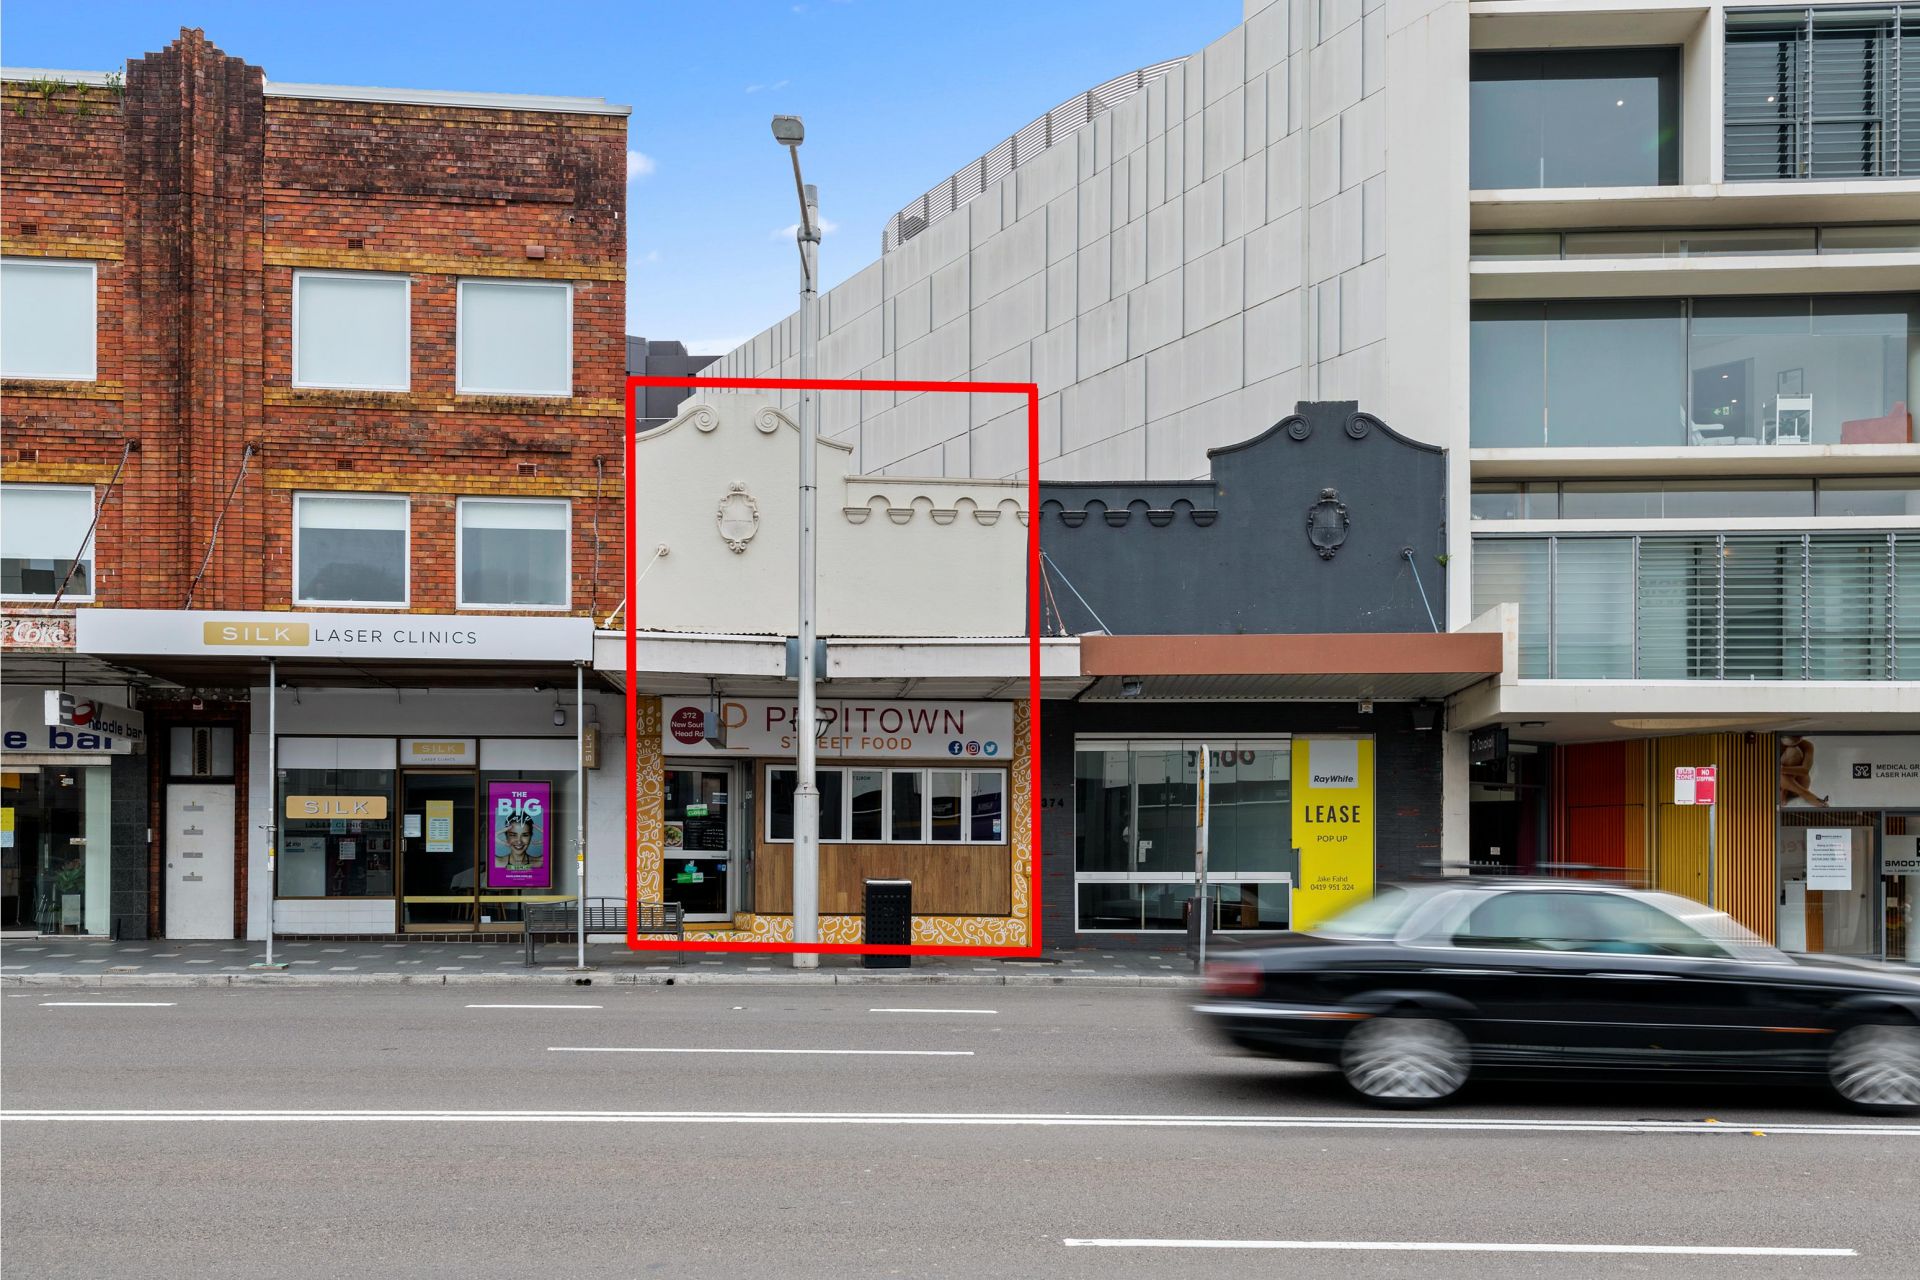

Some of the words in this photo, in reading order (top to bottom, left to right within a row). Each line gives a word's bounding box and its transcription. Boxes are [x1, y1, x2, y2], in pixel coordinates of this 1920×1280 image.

[223, 627, 290, 641] SILK
[315, 629, 382, 643] LASER
[393, 630, 477, 644] CLINICS
[766, 706, 965, 735] PPITOWN
[88, 719, 123, 736] noodle
[126, 724, 142, 739] bar
[422, 744, 456, 754] SILK
[781, 735, 853, 749] SEET
[861, 737, 912, 750] FOOD
[1876, 763, 1908, 771] MEDICAL
[1313, 775, 1354, 784] RayWhite
[304, 801, 369, 815] SILK
[497, 798, 542, 816] BIG
[1041, 798, 1064, 808] 374
[1305, 805, 1361, 823] LEASE
[1317, 835, 1334, 843] POP
[1336, 835, 1348, 843] UP
